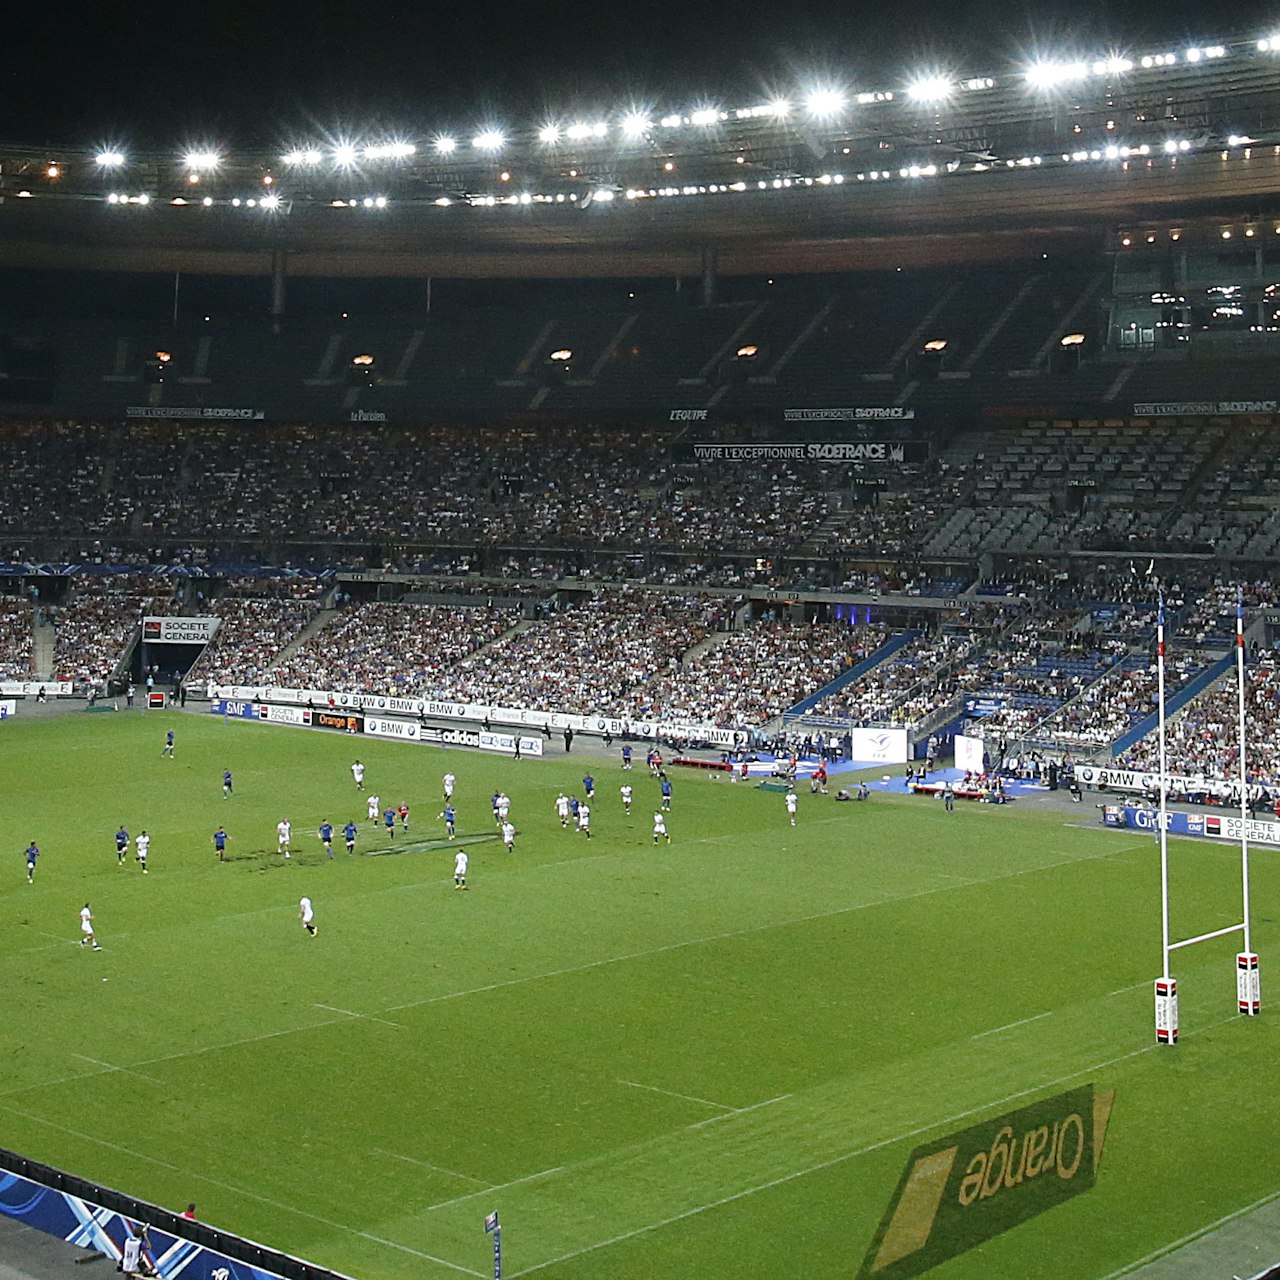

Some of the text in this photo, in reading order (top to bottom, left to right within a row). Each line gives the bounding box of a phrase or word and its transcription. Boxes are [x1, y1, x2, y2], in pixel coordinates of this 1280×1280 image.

[694, 448, 722, 459] VIVRE
[725, 448, 805, 459] L'EXCEPTIONNEL
[165, 622, 210, 631] SOCIETE
[352, 695, 375, 706] BMW
[389, 699, 413, 710] BMW
[226, 701, 245, 716] GMF
[270, 706, 295, 715] SOCIETE
[429, 701, 453, 714] BMW
[270, 713, 299, 723] GENERALE
[319, 714, 345, 727] Orange
[380, 723, 404, 734] BMW
[442, 730, 479, 746] adidas
[1098, 770, 1135, 786] BMW
[1188, 822, 1203, 831] GMF
[1227, 818, 1274, 832] SOCIETE
[959, 1113, 1084, 1206] Orange
